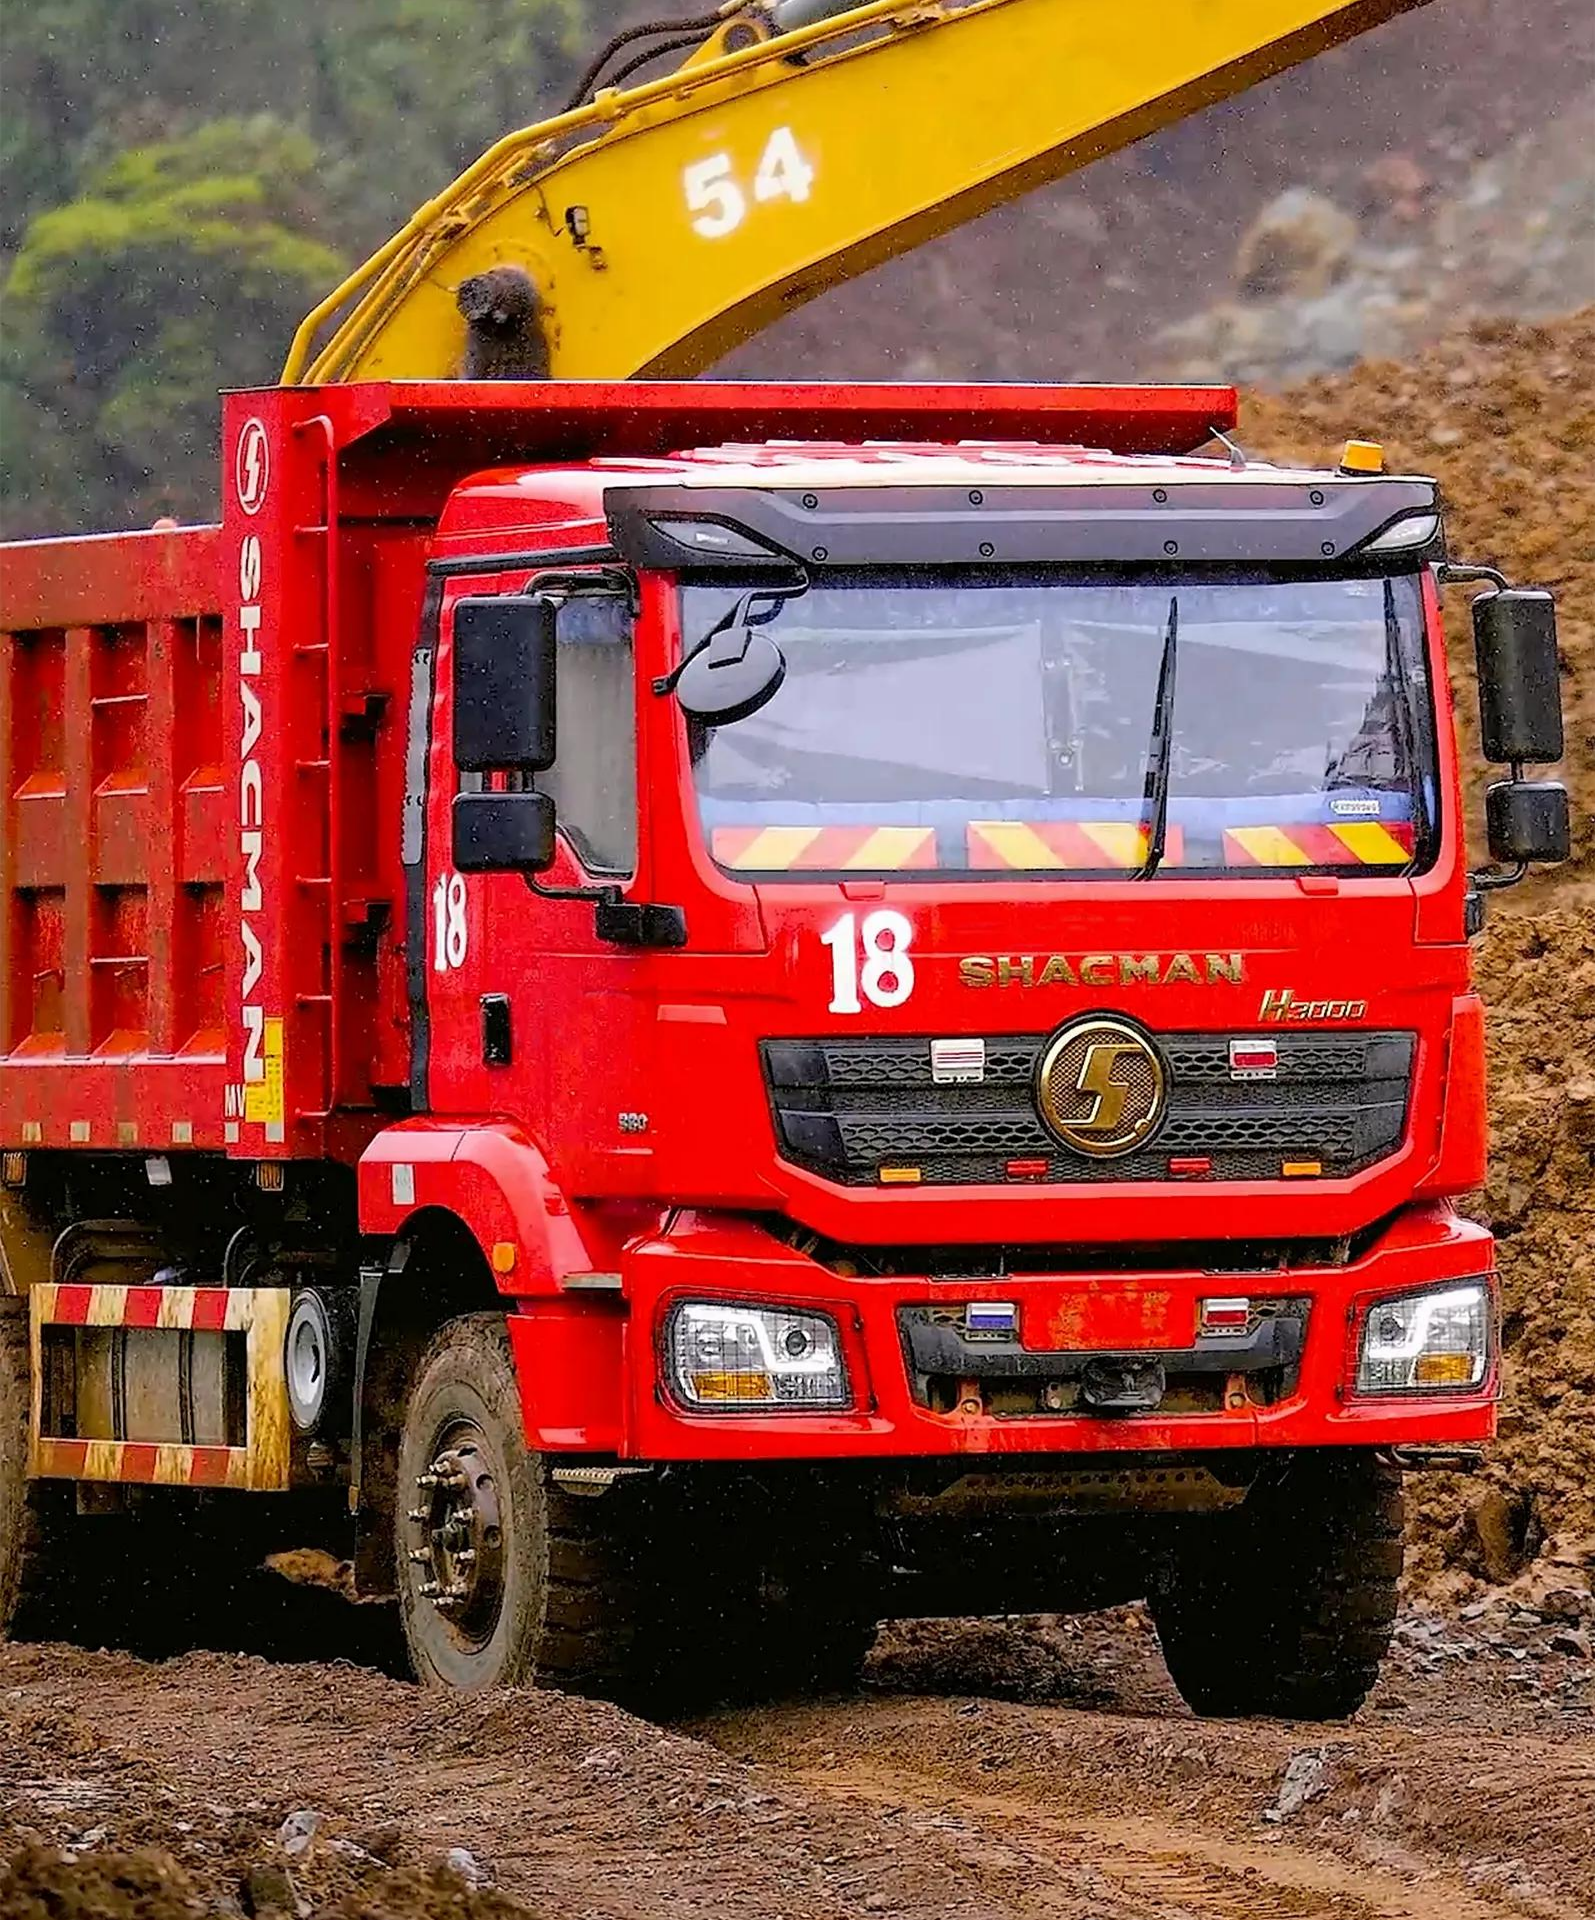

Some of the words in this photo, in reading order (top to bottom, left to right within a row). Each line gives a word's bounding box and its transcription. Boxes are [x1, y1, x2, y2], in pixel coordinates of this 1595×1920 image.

[684, 126, 813, 238] 54
[240, 536, 264, 1082] SHACMAN
[433, 872, 467, 972] 18
[820, 909, 914, 1014] 18
[958, 952, 1246, 988] SHACMAN
[1258, 989, 1367, 1021] H3000
